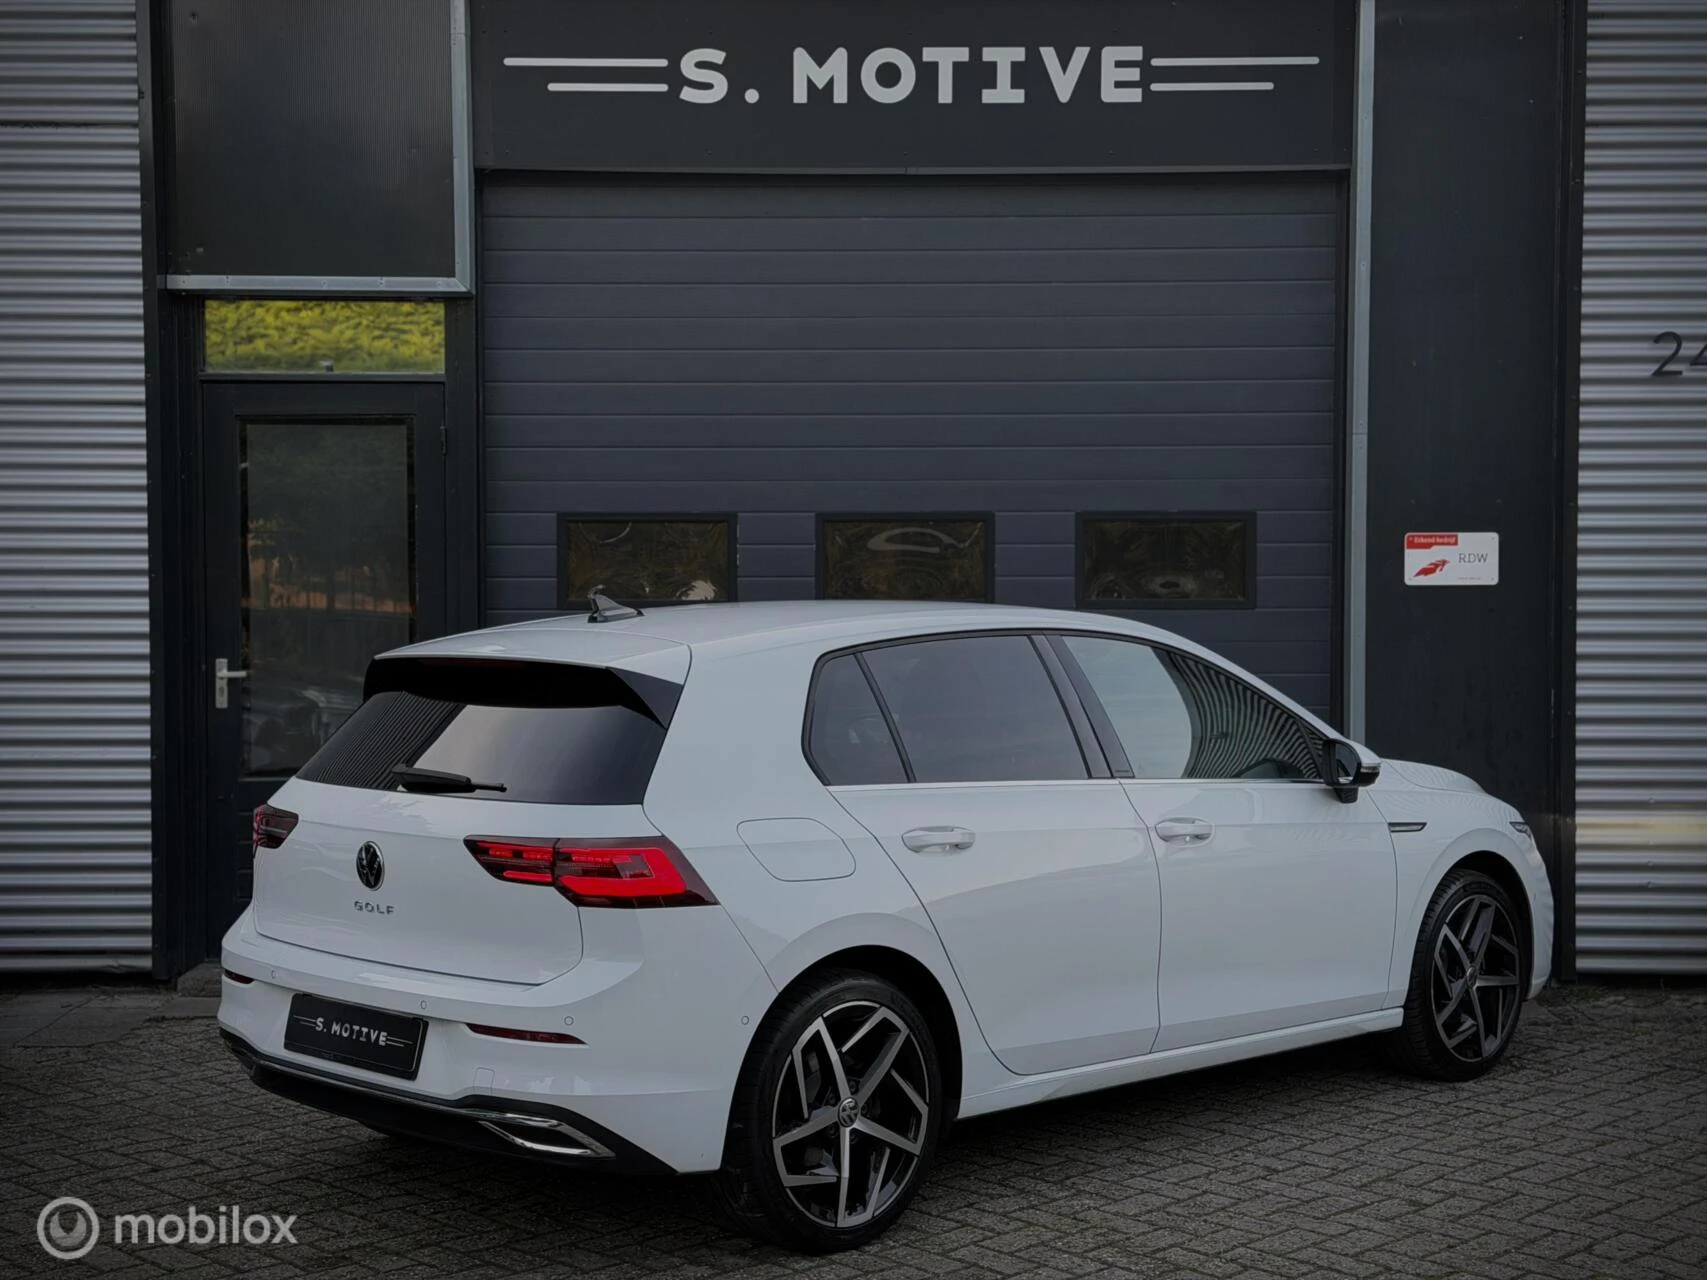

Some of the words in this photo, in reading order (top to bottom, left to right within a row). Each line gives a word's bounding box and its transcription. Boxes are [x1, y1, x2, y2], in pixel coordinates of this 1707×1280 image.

[679, 47, 760, 105] S.
[793, 45, 1146, 105] MOTIVE
[1458, 552, 1489, 564] RDW
[354, 901, 395, 915] GOLF
[315, 1017, 327, 1033] S.
[331, 1021, 389, 1047] MOTIVE
